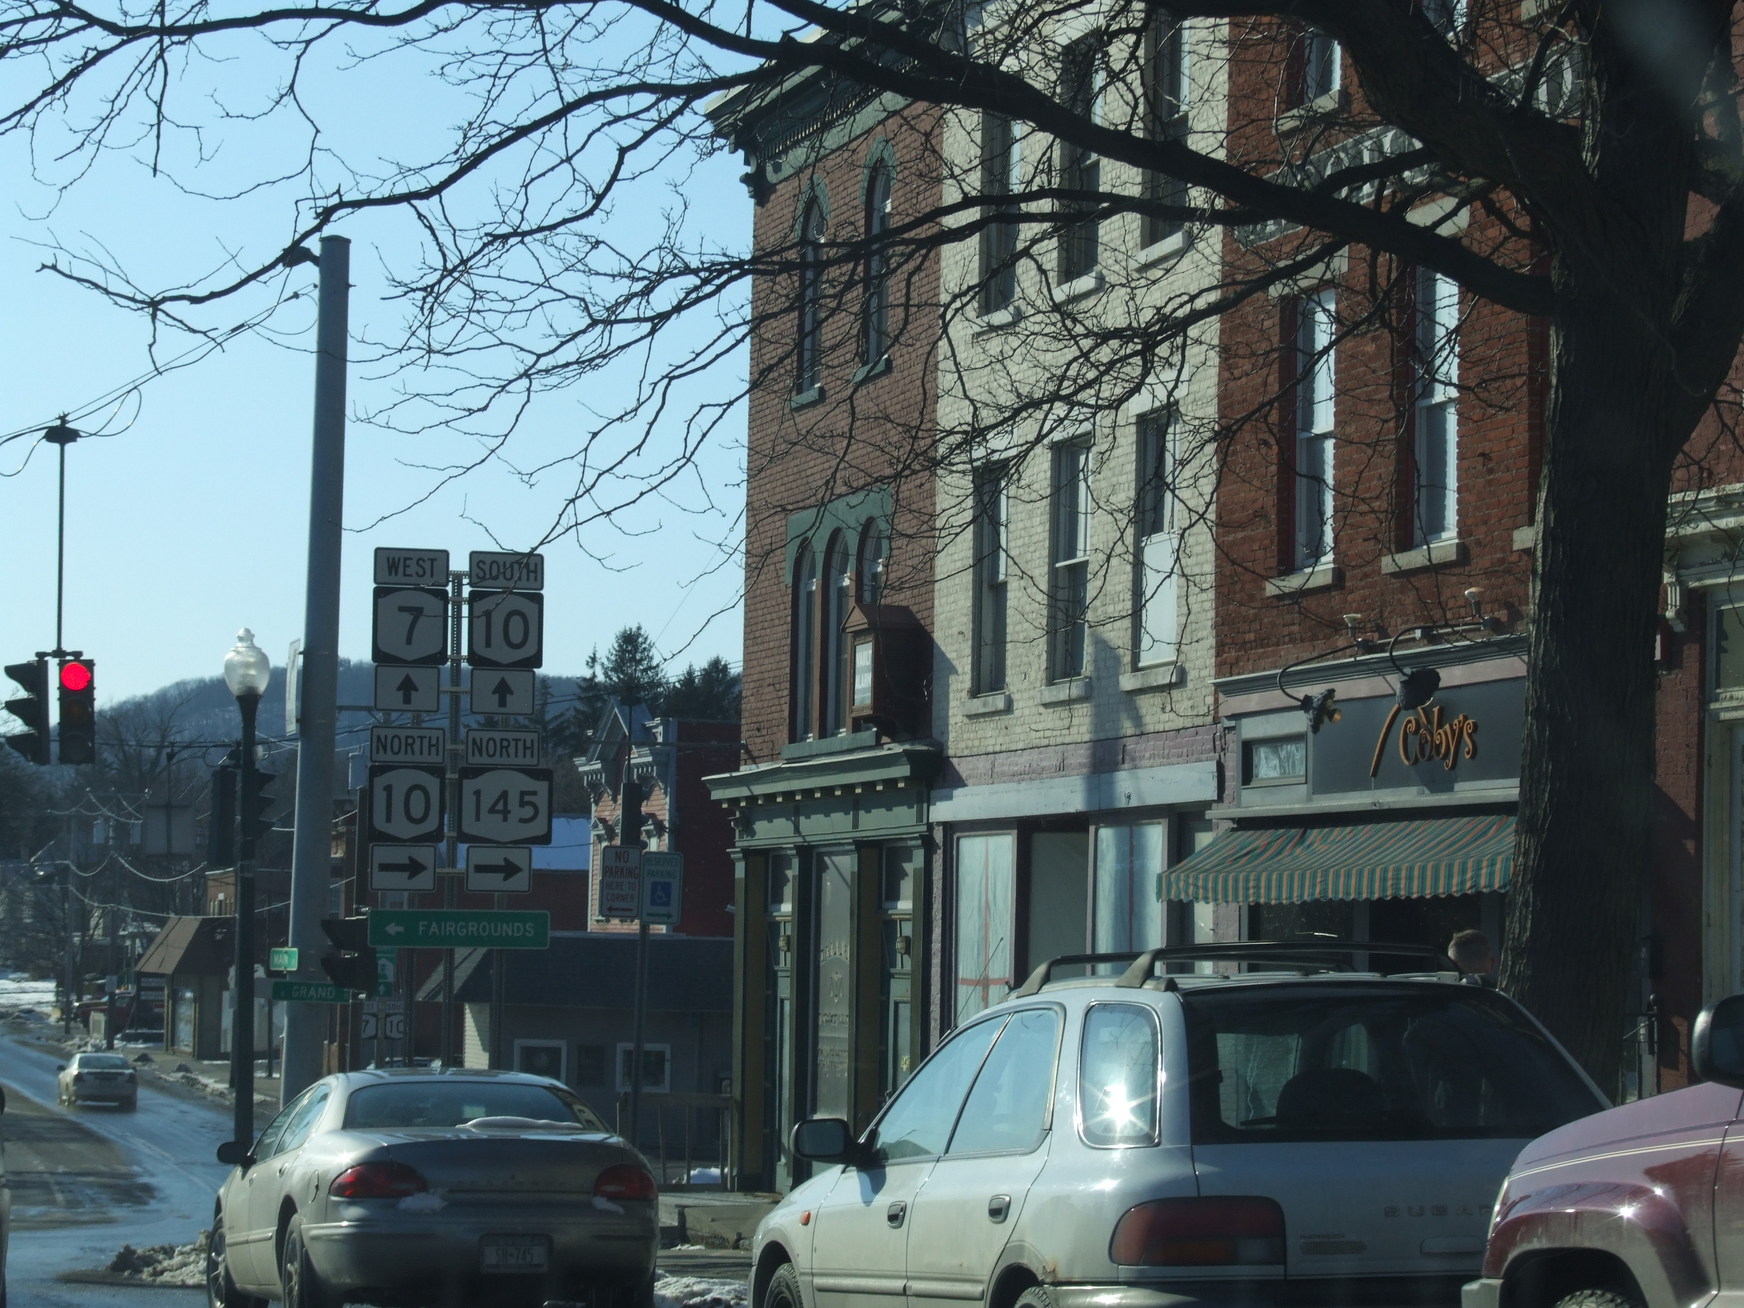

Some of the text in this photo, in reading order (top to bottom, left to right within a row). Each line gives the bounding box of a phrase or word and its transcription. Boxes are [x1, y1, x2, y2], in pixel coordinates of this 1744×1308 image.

[386, 556, 438, 578] WEST
[475, 559, 539, 584] SOUTH
[397, 605, 425, 646] 7
[482, 608, 530, 650] 10
[375, 734, 440, 757] NORTH
[471, 737, 535, 759] NORTH
[383, 783, 432, 825] 10
[472, 788, 540, 824] 145
[614, 850, 630, 864] NO
[645, 856, 680, 867] RESERVED
[604, 865, 639, 879] PARKING
[646, 869, 678, 880] PARKING
[605, 881, 637, 891] HERE TO
[606, 893, 635, 902] CORNER
[418, 921, 535, 937] FAIRGROUNDS
[291, 985, 336, 999] GRAND
[1384, 1204, 1493, 1217] SUBAR
